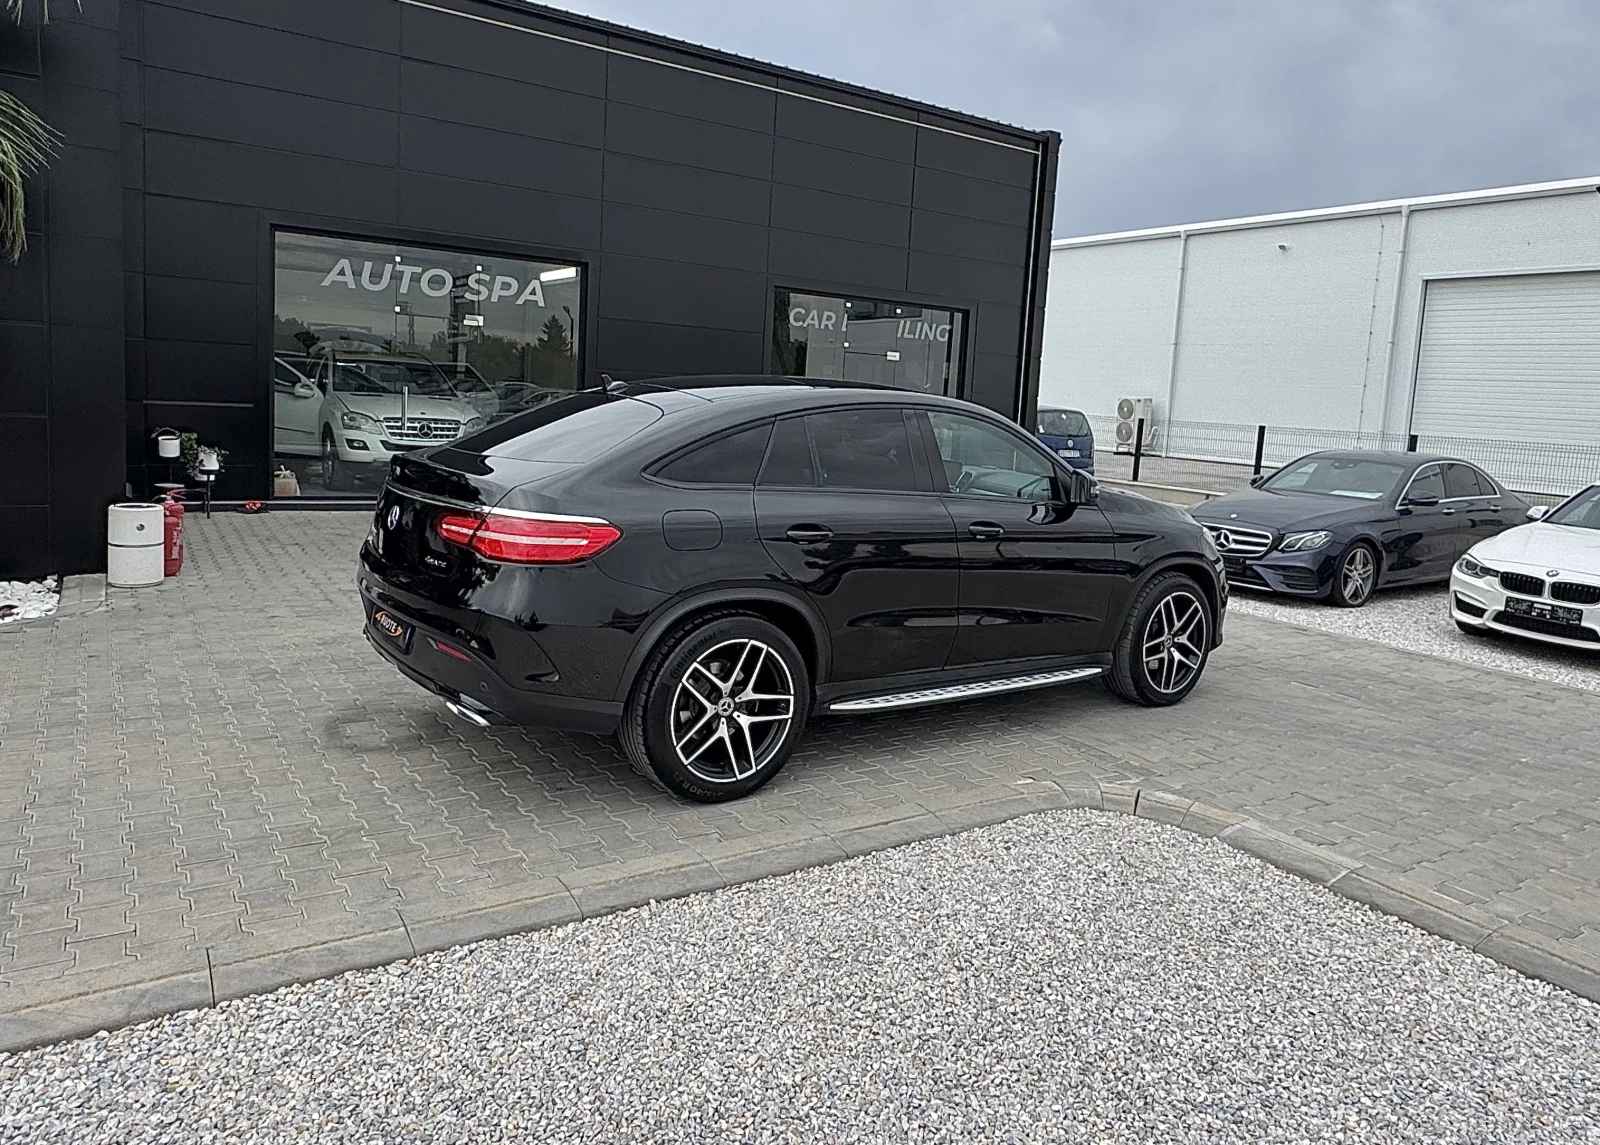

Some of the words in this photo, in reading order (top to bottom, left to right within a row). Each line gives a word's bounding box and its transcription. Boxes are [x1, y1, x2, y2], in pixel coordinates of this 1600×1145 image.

[320, 258, 453, 298] AUTO
[463, 273, 546, 307] SPA
[789, 307, 837, 330] CAR
